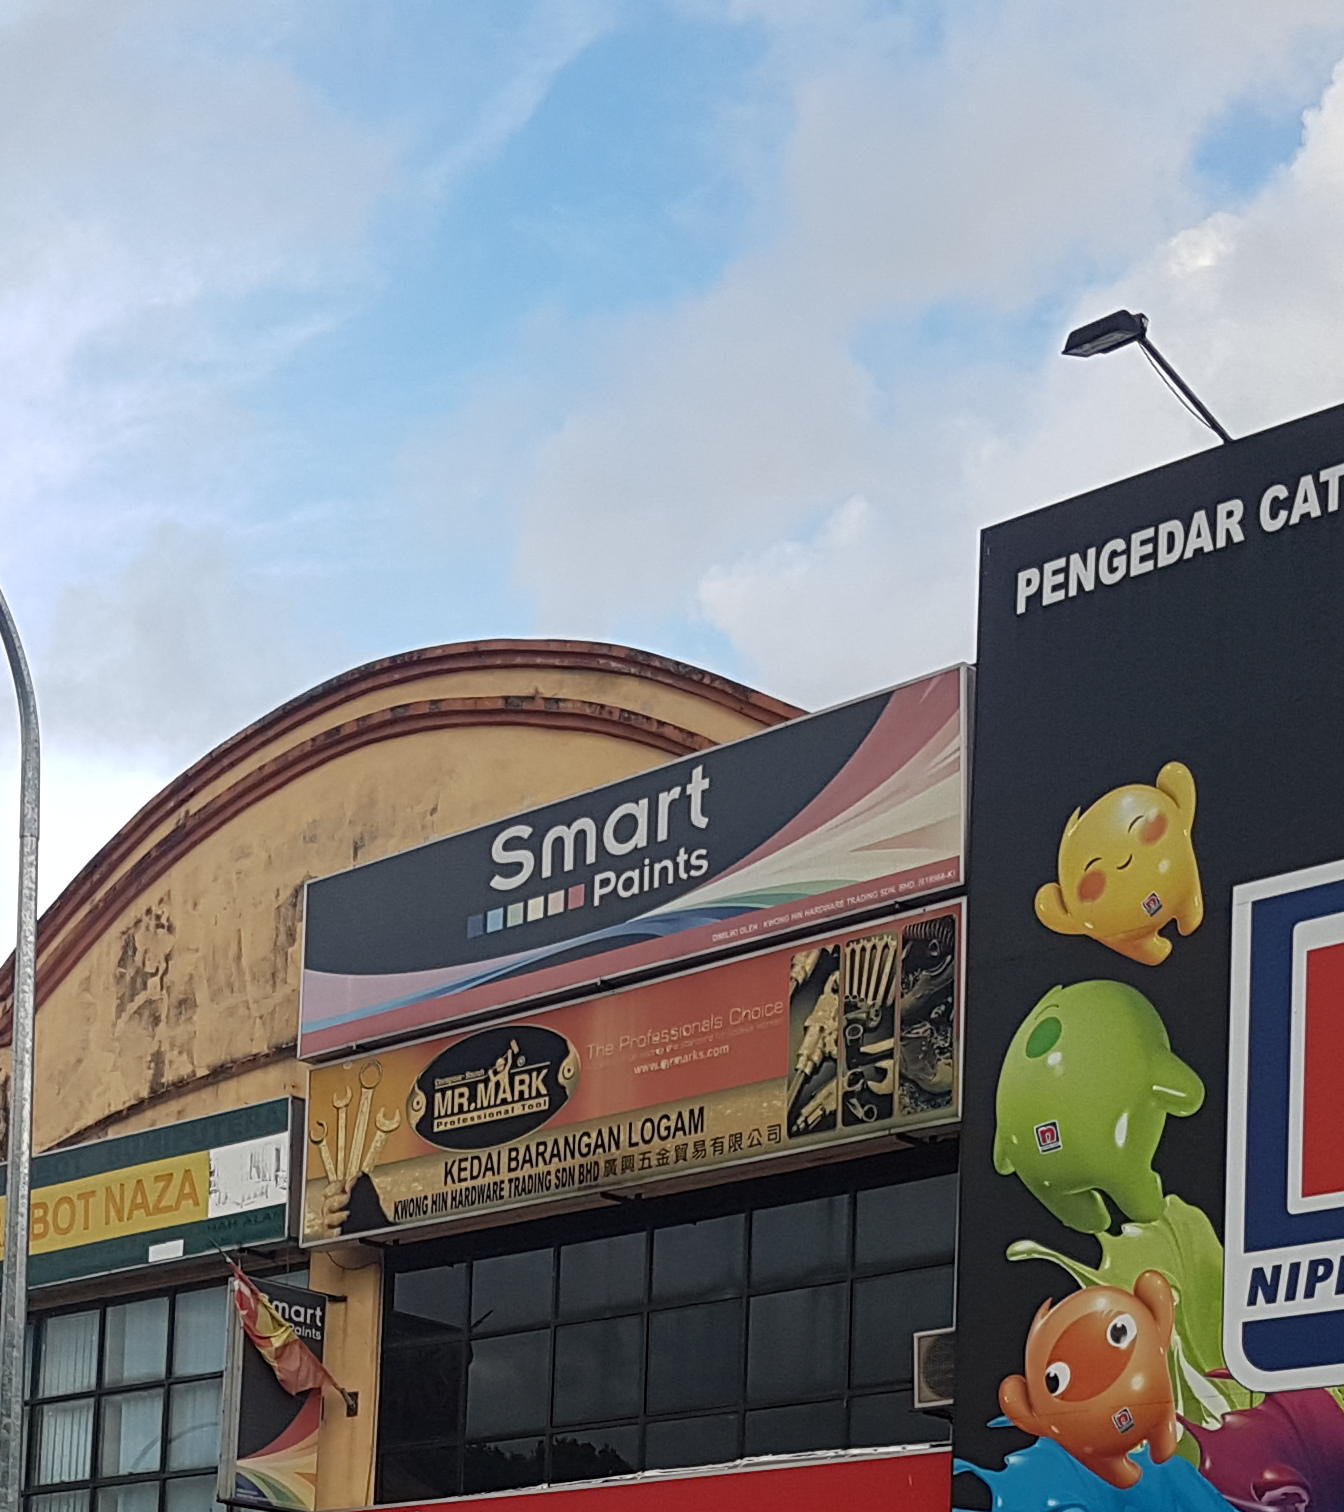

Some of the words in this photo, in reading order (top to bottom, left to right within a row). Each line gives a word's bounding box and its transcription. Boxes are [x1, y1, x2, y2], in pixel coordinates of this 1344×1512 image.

[1015, 497, 1244, 615] PENGEDAR
[491, 764, 710, 891] Smart
[594, 844, 708, 906] Paints
[764, 914, 789, 928] KWONG
[804, 899, 845, 918] HARDWARE
[847, 892, 878, 907] TRADING
[587, 1043, 613, 1059] The
[620, 1014, 722, 1052] Professionals
[730, 1001, 784, 1026] Choice
[434, 1069, 548, 1118] MR.MARK
[436, 1107, 514, 1128] Professional
[521, 1100, 546, 1112] Tool
[444, 1151, 502, 1186] KEDAI
[509, 1124, 622, 1173] BARANGAN
[628, 1106, 705, 1148] LOGAM
[105, 1167, 200, 1225] NAZA
[393, 1199, 428, 1221] KWONG
[431, 1196, 448, 1215] HIN
[449, 1181, 504, 1210] HARDWARE
[508, 1170, 552, 1199] TRADING
[555, 1166, 577, 1190] SDN
[578, 1161, 600, 1183] BHD
